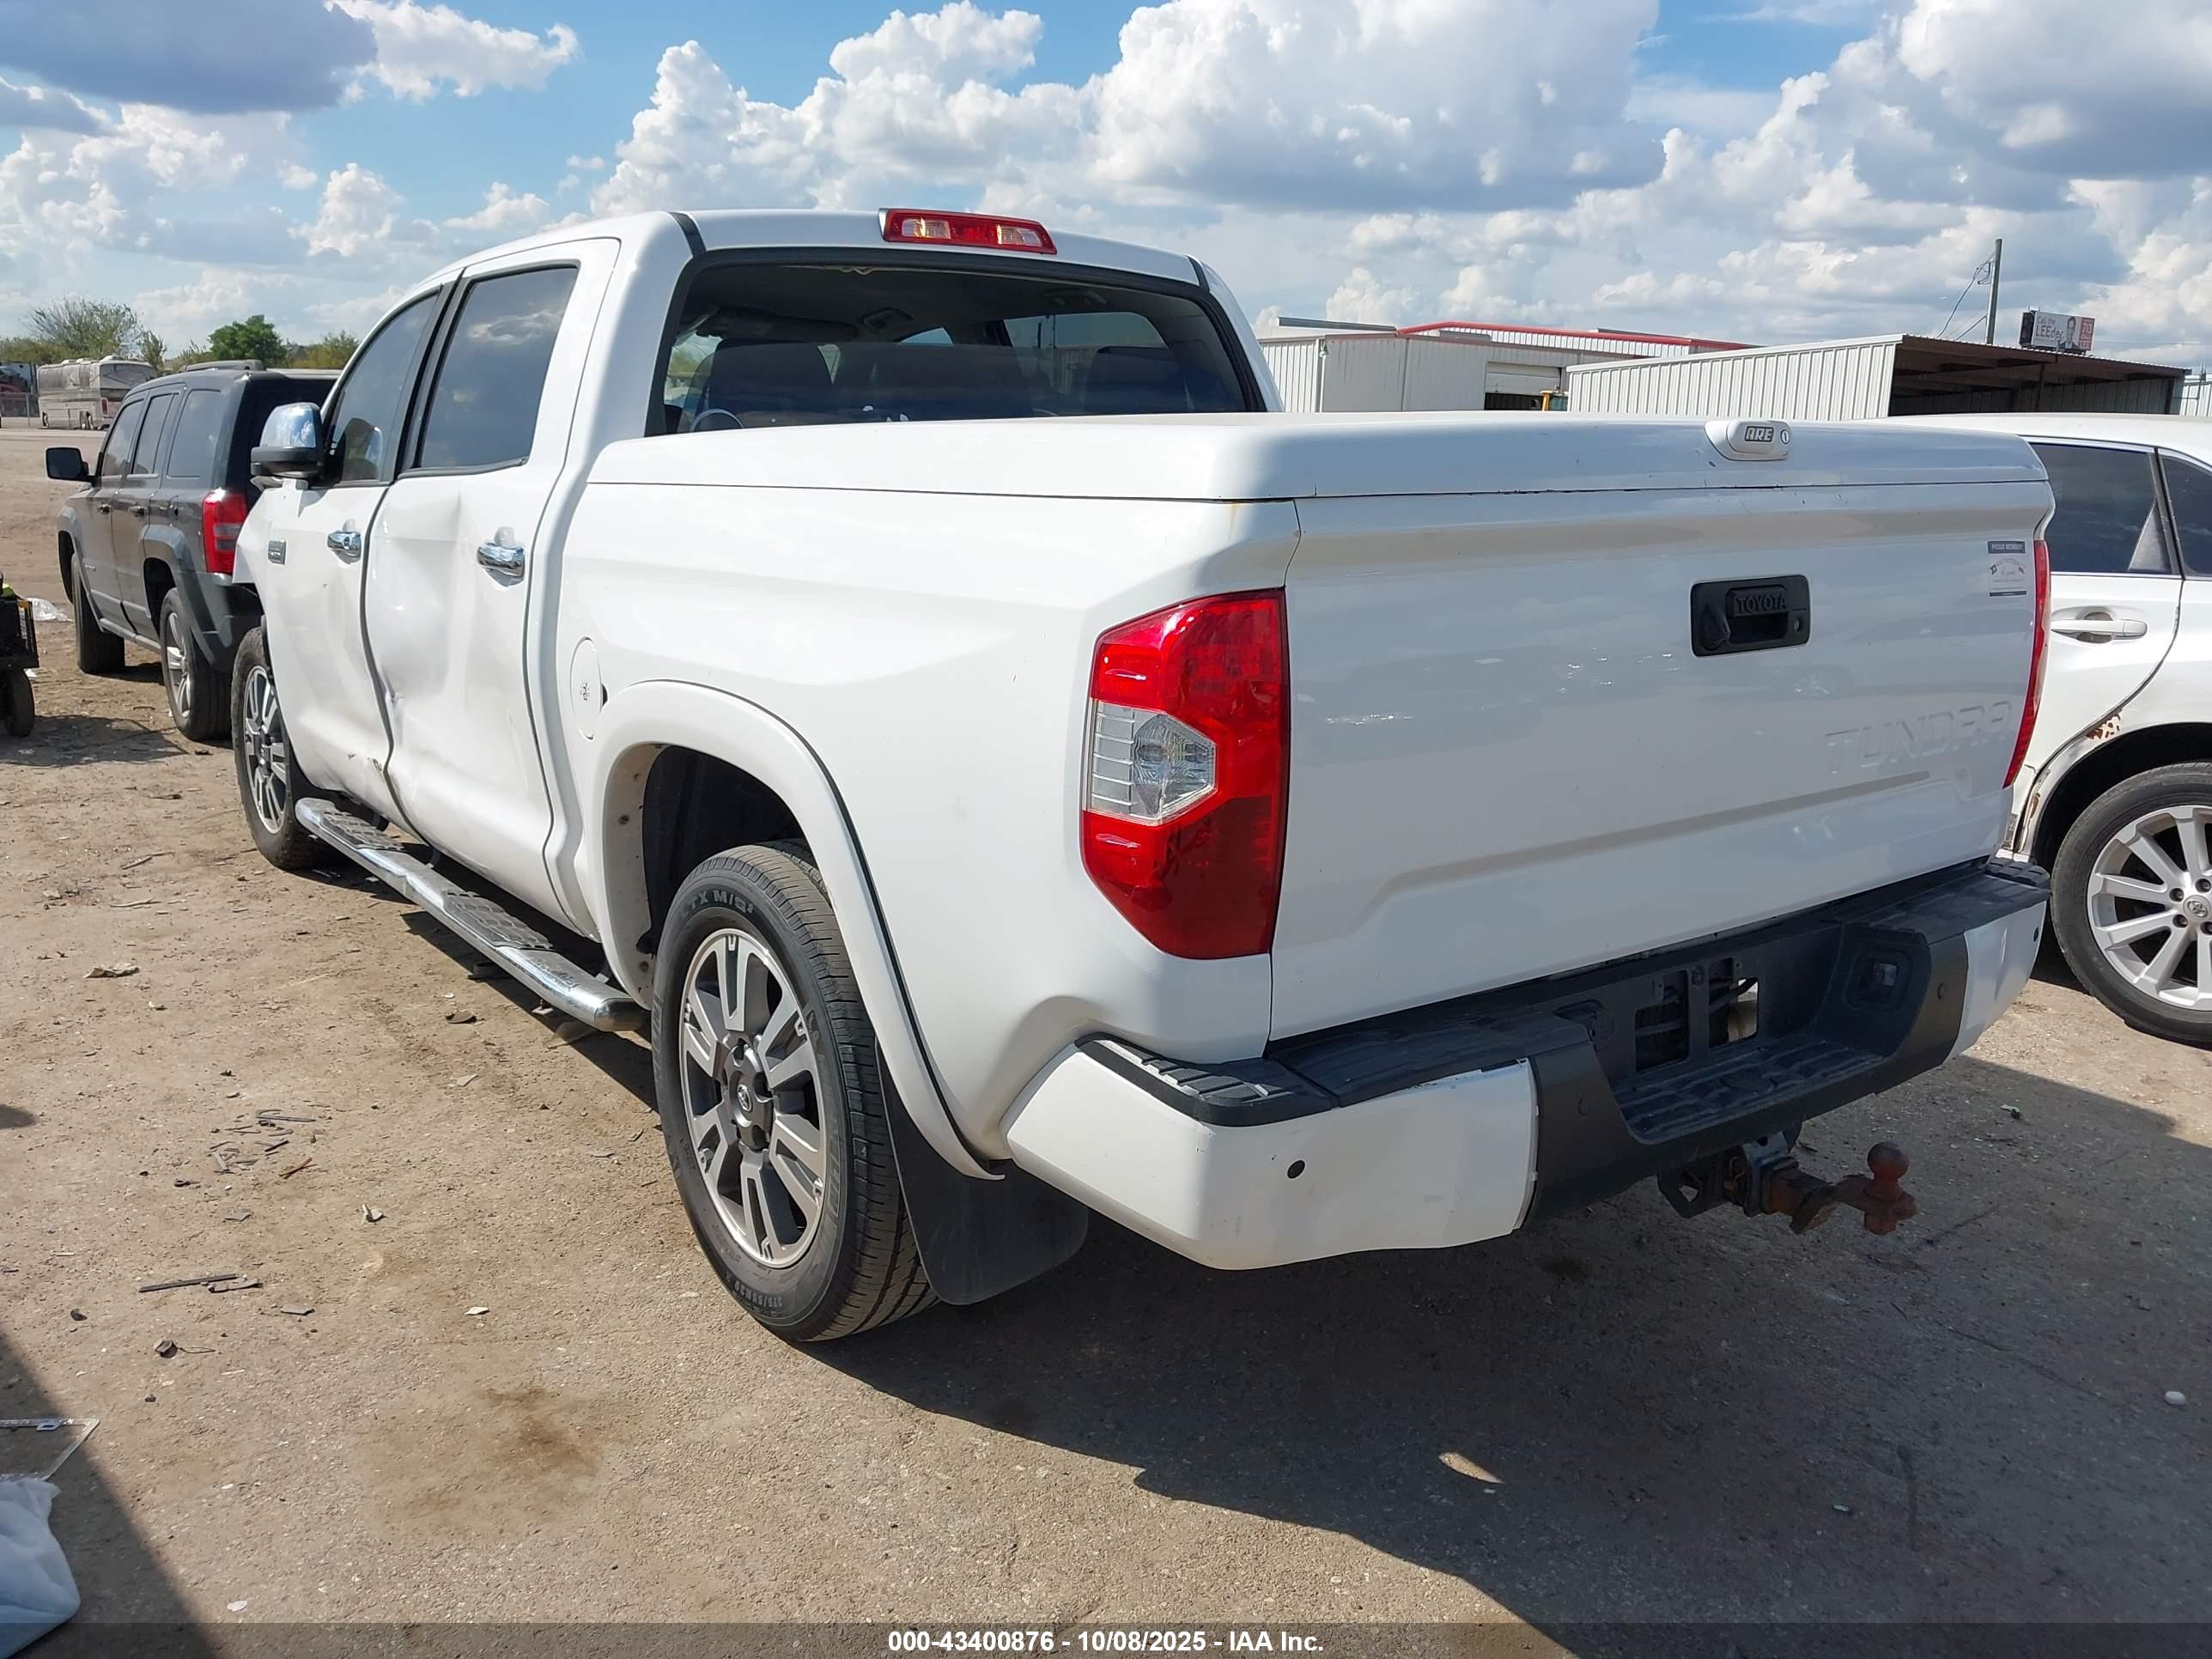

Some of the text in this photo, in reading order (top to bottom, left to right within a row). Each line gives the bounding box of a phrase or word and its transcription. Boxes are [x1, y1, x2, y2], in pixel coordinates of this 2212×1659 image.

[1746, 428, 1773, 441] ARE
[1735, 592, 1787, 613] TOYOTA
[1825, 700, 2013, 775] TUNDRA
